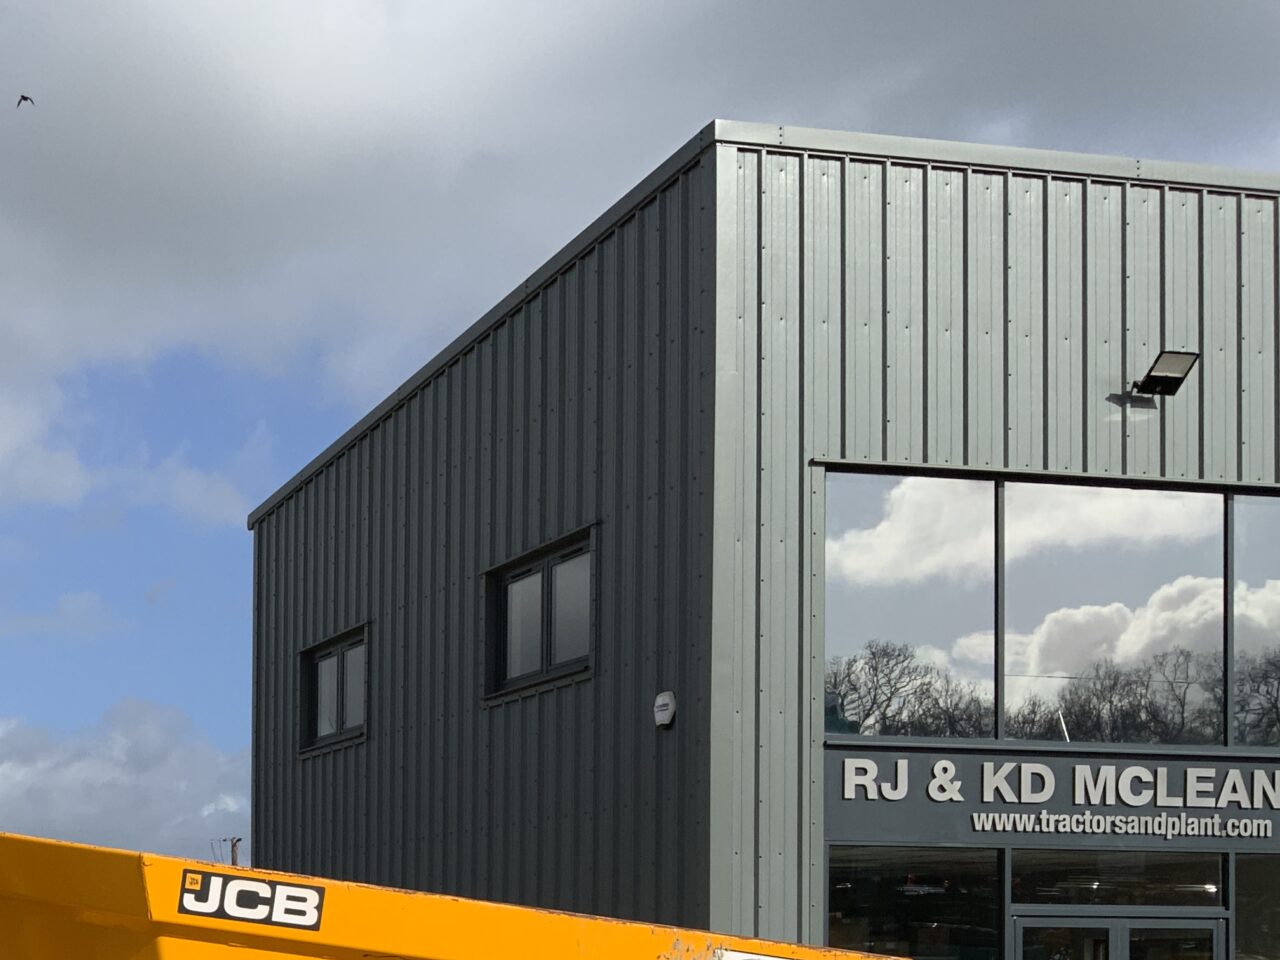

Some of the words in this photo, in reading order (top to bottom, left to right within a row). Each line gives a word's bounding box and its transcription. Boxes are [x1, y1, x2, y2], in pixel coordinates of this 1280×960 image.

[844, 758, 908, 801] RJ
[928, 759, 965, 802] &
[983, 762, 1056, 804] KD
[1074, 764, 1280, 809] MCLEAN
[972, 809, 1272, 839] www.tractorsandplant.com
[182, 876, 320, 926] JCB
